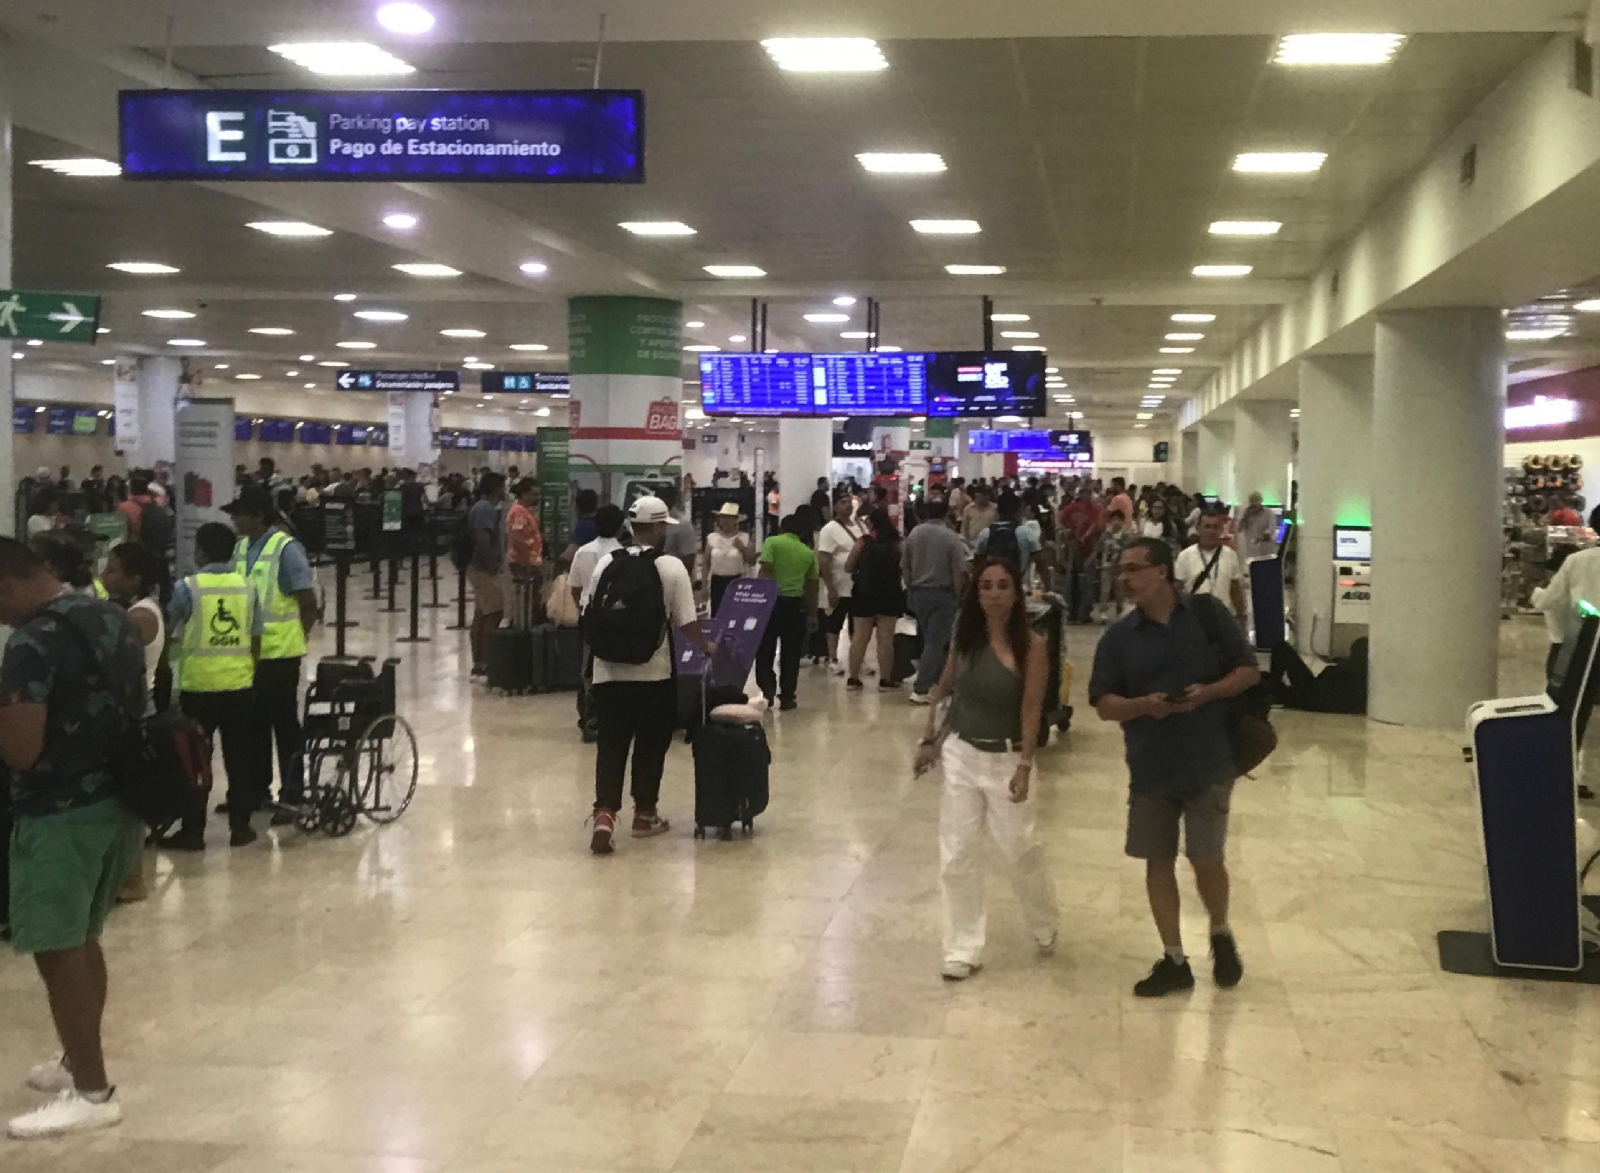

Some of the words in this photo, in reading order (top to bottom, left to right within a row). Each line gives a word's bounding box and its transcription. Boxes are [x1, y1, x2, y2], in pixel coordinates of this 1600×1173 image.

[329, 114, 392, 134] Parking
[396, 116, 428, 134] pay
[431, 114, 490, 131] station
[207, 111, 247, 161] E
[329, 138, 376, 159] Pago
[380, 139, 404, 155] de
[407, 138, 561, 156] Estacionamiento
